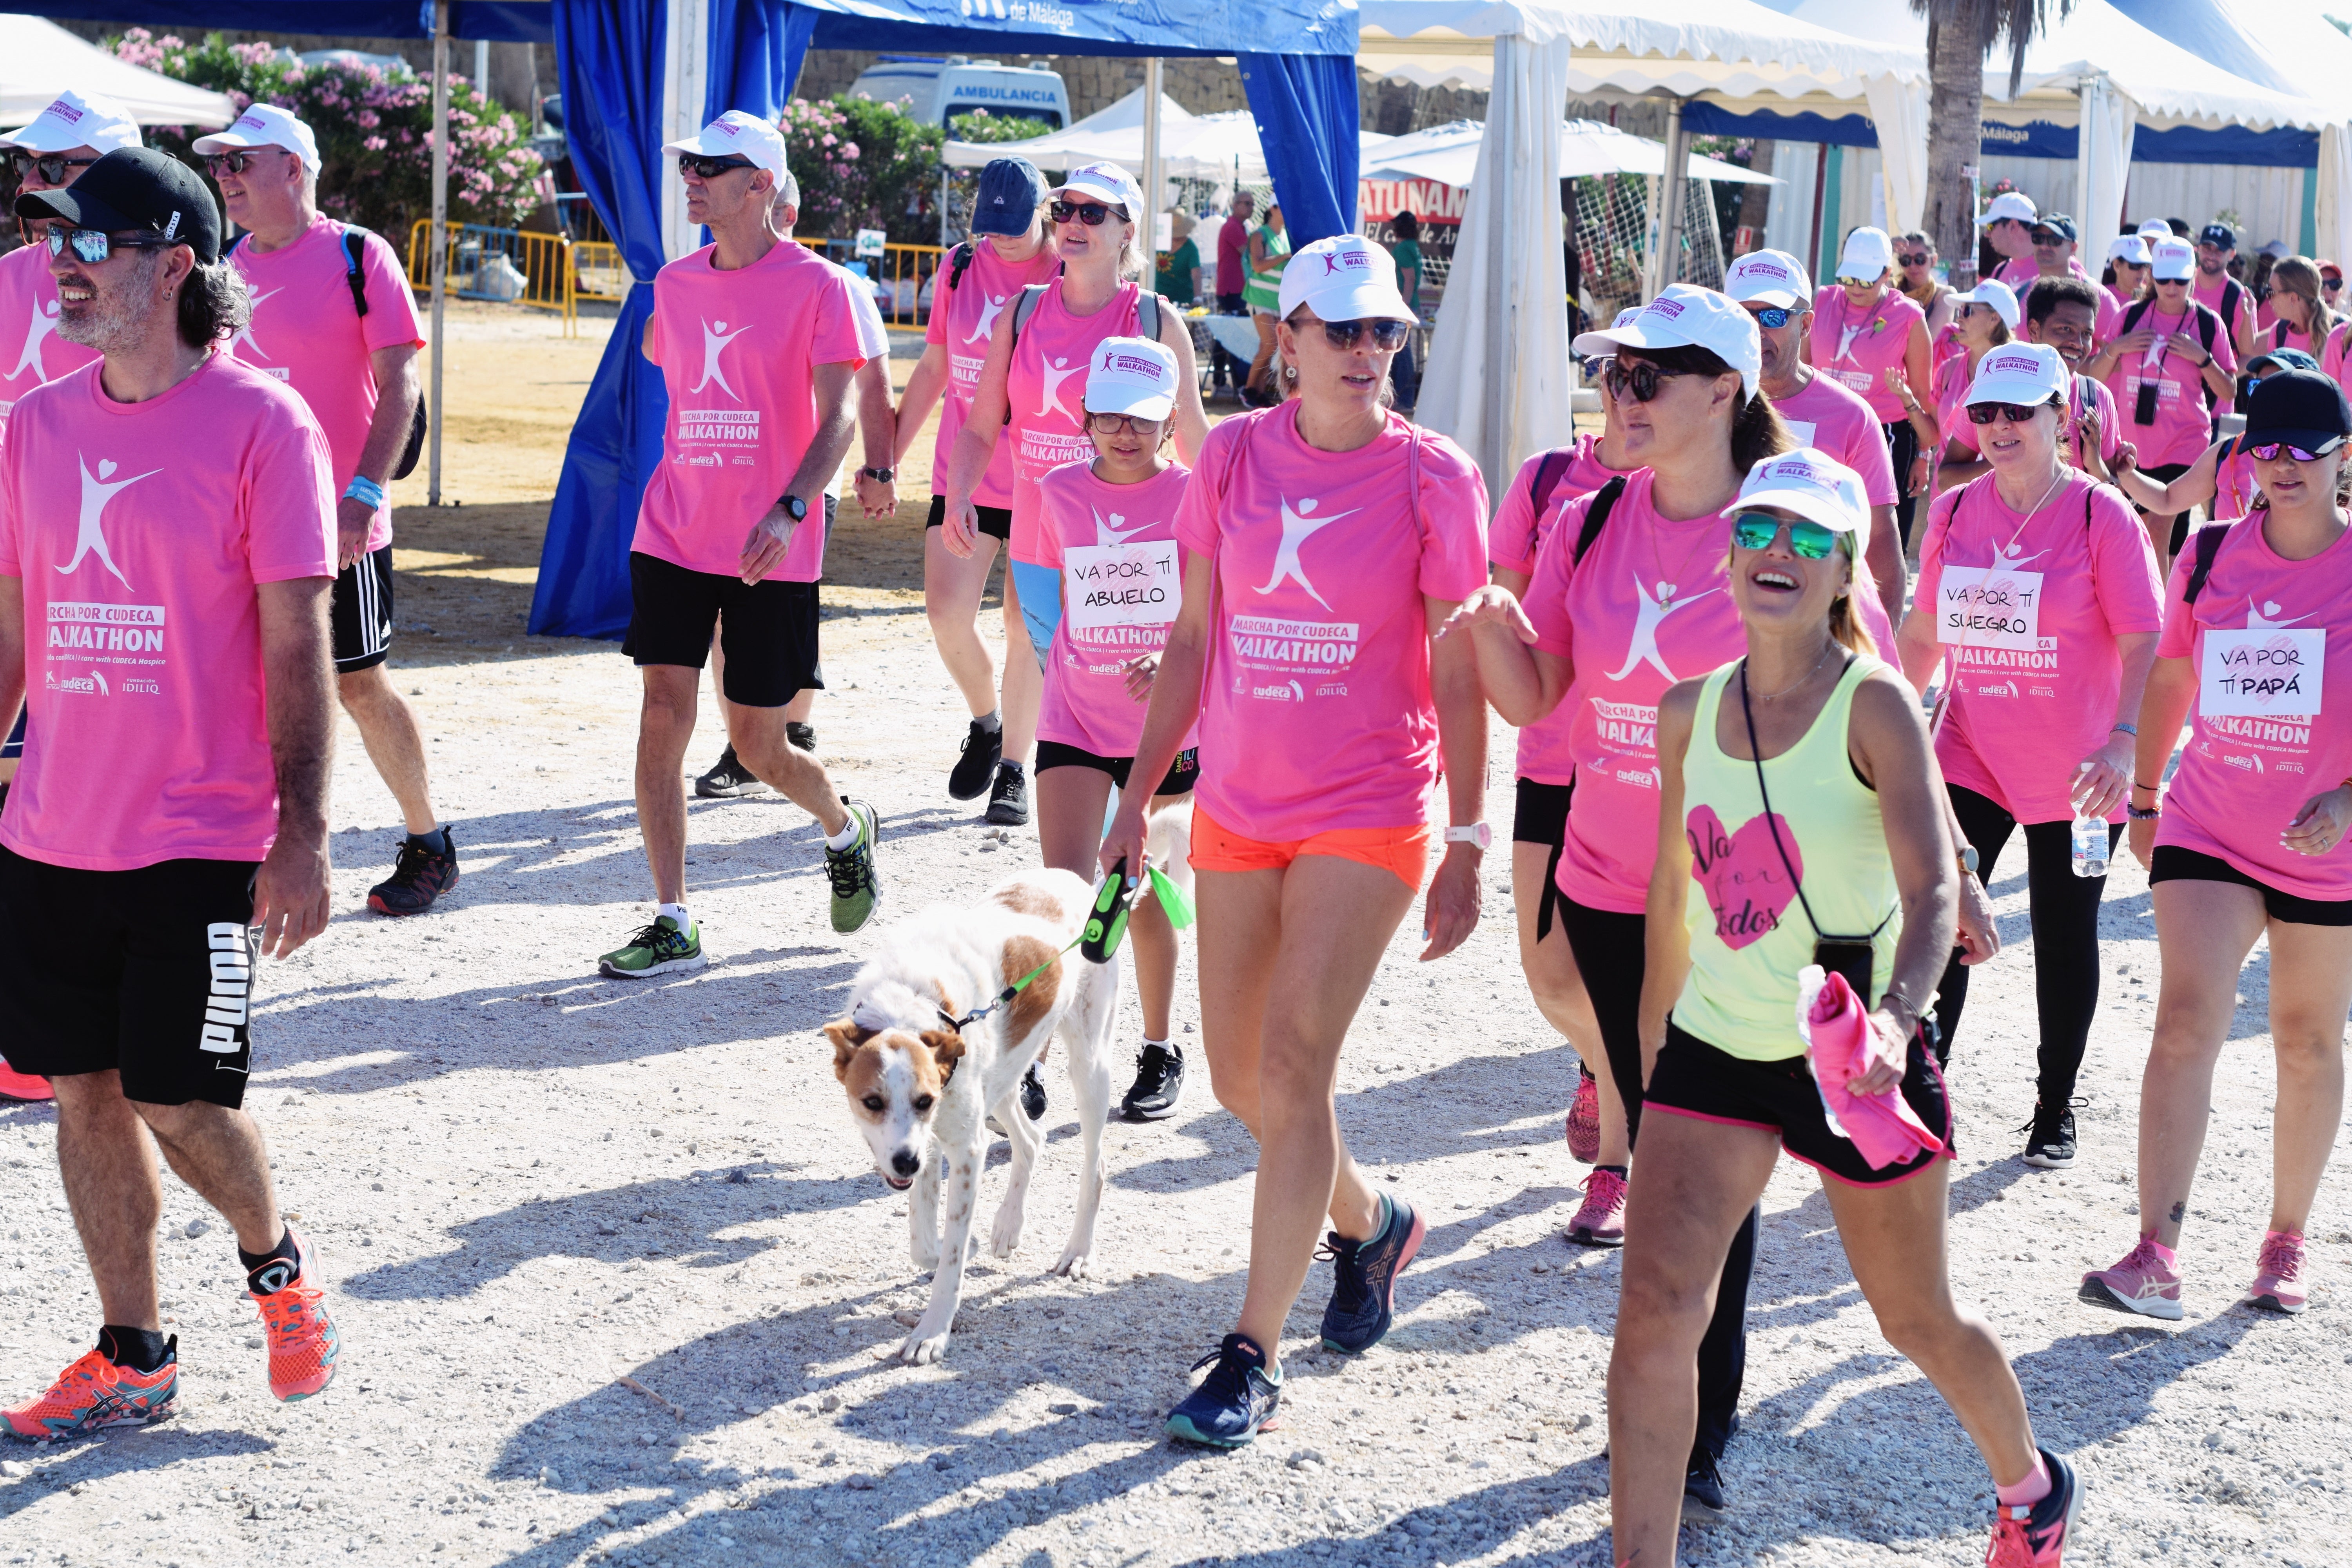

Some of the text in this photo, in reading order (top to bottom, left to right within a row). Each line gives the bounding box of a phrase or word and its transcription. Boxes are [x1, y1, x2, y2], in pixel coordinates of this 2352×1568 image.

[1010, 2, 1074, 30] de Málaga
[953, 85, 1056, 103] AMBULANCIA
[165, 215, 178, 238] KIPSTA
[1749, 268, 1786, 279] WALKATHON
[1117, 361, 1160, 378] WALKATHON
[1996, 362, 2038, 373] WALKATHON
[678, 425, 759, 440] WALKATHON
[1045, 436, 1062, 445] POR
[1020, 441, 1094, 461] WALKATHON
[690, 456, 714, 464] cudeca
[1075, 555, 1171, 580] VA POR TÍ
[1085, 588, 1165, 606] ABUELO
[1947, 588, 2034, 608] VA POR TÍ
[78, 607, 101, 619] POR
[105, 608, 155, 622] CUDECA
[1234, 619, 1349, 637] MARCHA POR CUDECA
[1947, 613, 2026, 633] SUEGRO
[47, 625, 163, 652] ALKATHON
[1070, 628, 1166, 646] WALKATHON
[138, 658, 166, 666] Hospice
[1951, 646, 2058, 669] WALKATHON
[2220, 649, 2305, 665] VA POR
[1089, 664, 1120, 673] cudeca
[122, 683, 161, 695] IDILIQ
[1253, 685, 1290, 699] cudeca
[1316, 686, 1348, 697] IDILIQ
[1979, 685, 2008, 695] cudeca
[2219, 673, 2300, 695] TÍ PAPÁ
[2029, 688, 2055, 698] IDILIQ
[2219, 735, 2234, 744] CUDECA
[2223, 755, 2253, 769] cudeca
[2276, 764, 2305, 774] IDILIQ
[1617, 770, 1653, 786] cudeca
[1687, 821, 1737, 875] Va
